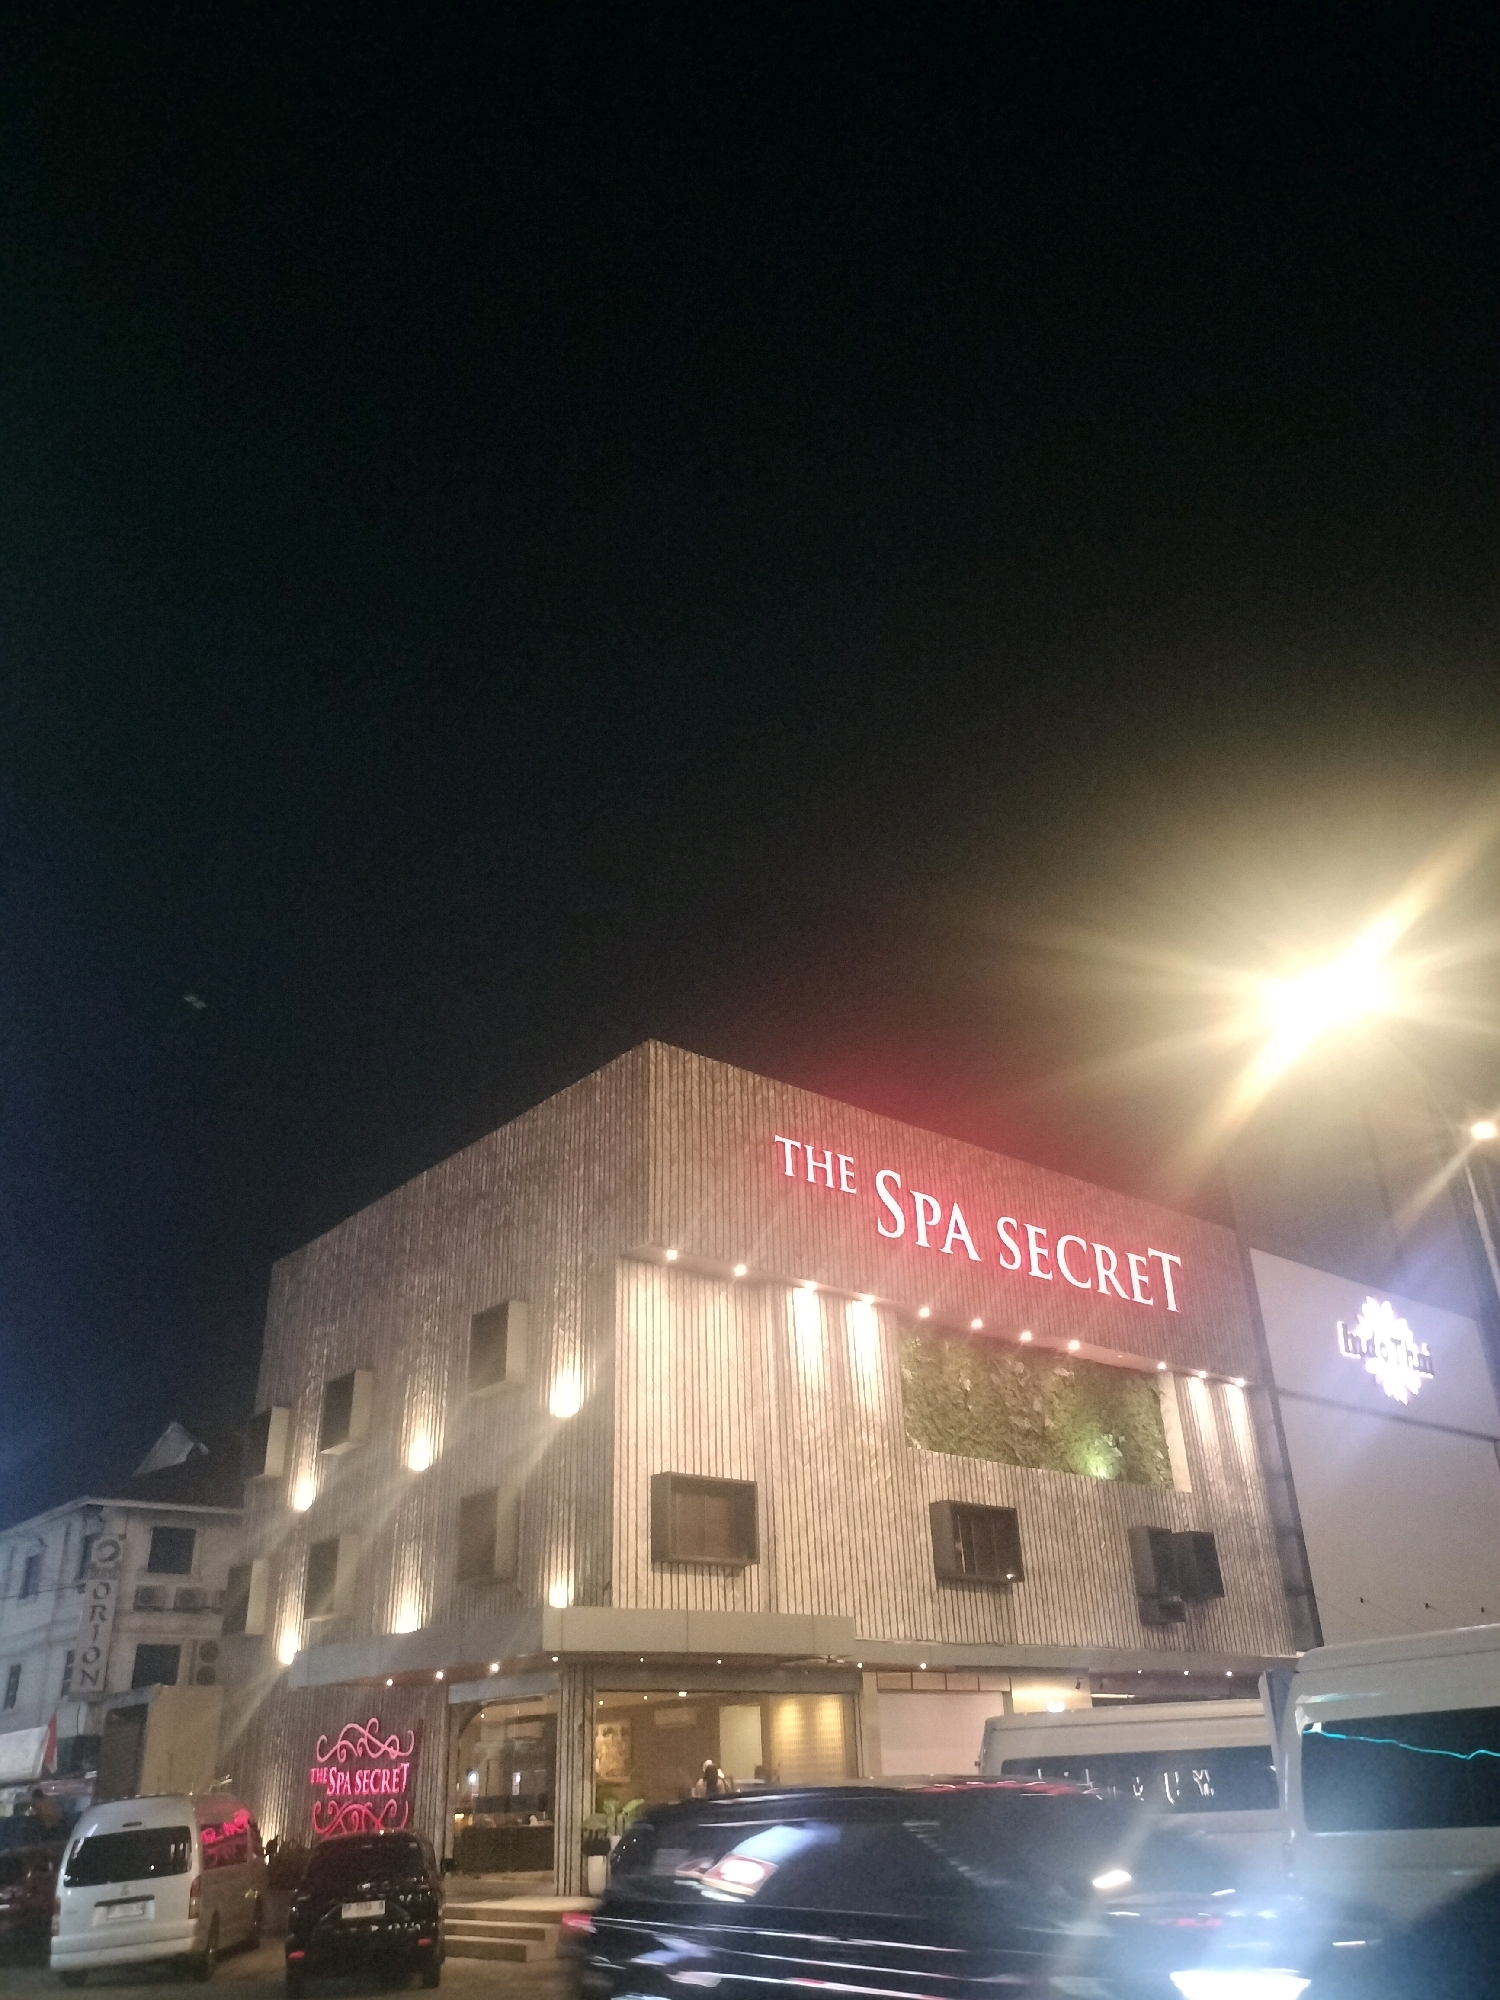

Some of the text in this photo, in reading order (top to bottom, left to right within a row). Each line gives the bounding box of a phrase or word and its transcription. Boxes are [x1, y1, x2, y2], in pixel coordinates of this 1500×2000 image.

[774, 1135, 1182, 1313] THE SPA SECRET
[79, 1581, 112, 1686] ORION
[310, 1762, 410, 1796] THE SPA SECRET
